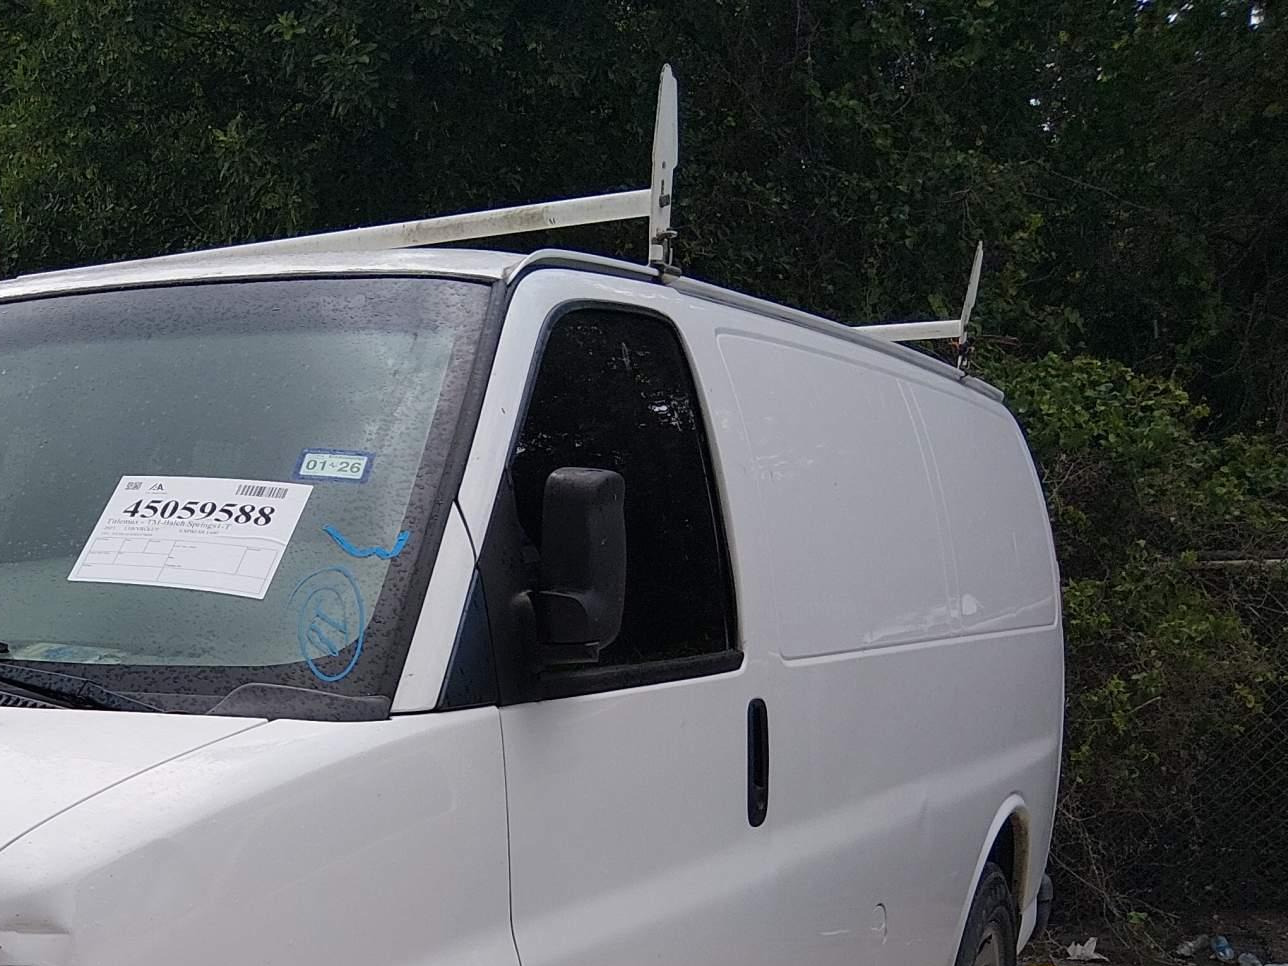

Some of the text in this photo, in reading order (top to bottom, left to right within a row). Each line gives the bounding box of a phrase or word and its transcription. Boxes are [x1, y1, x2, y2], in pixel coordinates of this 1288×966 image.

[305, 459, 362, 474] 01 26
[122, 499, 275, 527] 45059588
